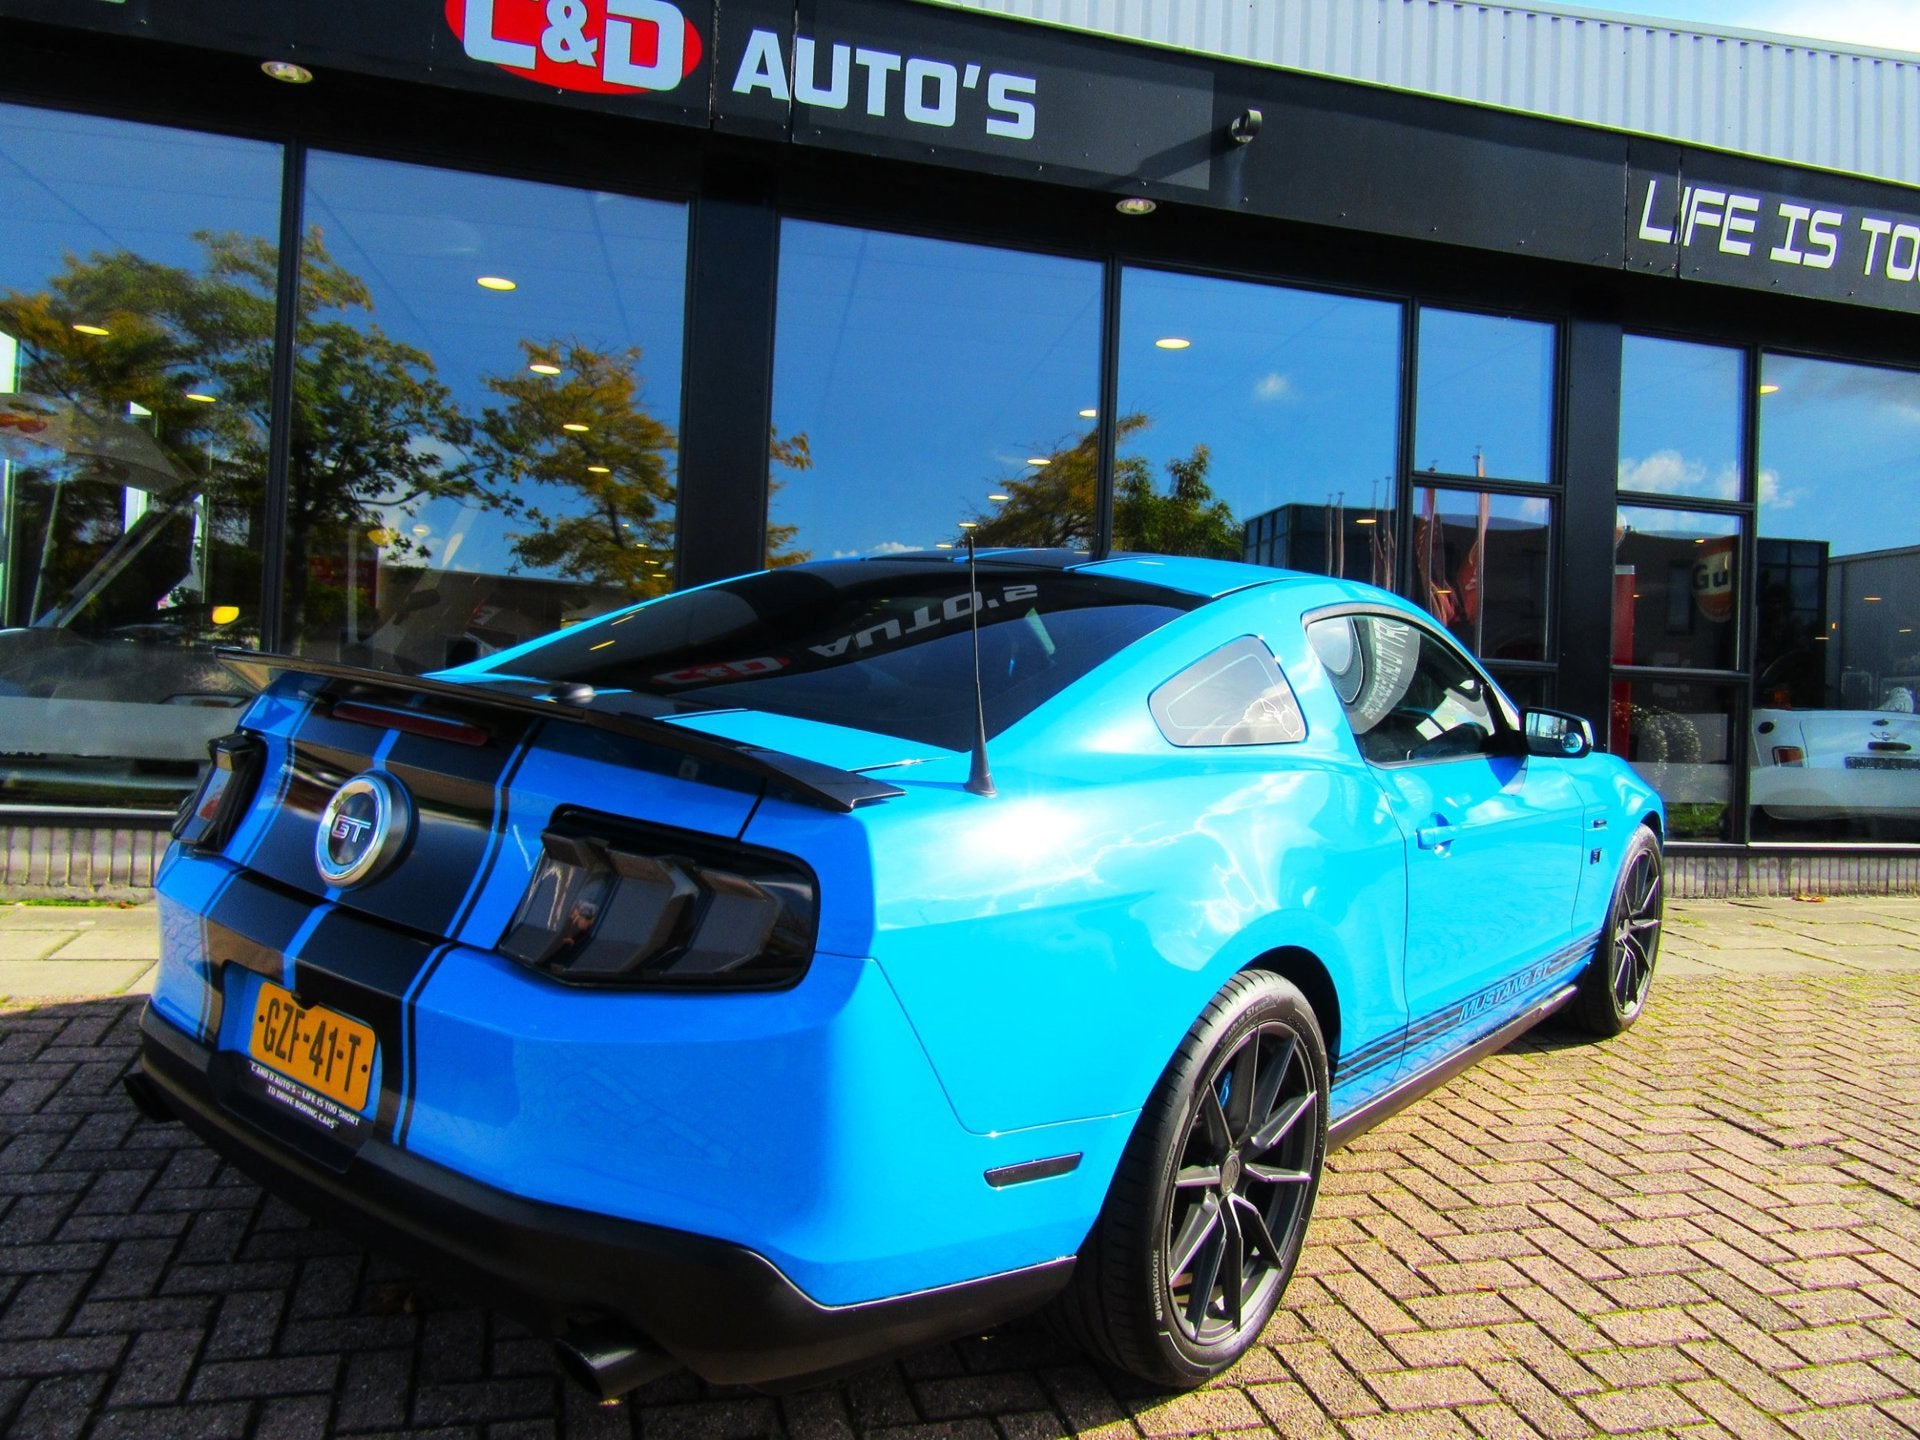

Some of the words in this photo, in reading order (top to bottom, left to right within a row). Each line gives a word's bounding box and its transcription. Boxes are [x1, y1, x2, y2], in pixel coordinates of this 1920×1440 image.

[463, 0, 686, 92] C&D
[732, 28, 1037, 141] AUTO'S
[1638, 180, 1760, 256] LIFE
[1769, 203, 1843, 269] IS
[1861, 217, 1920, 281] TO
[331, 814, 372, 843] GT
[1459, 970, 1532, 1021] MUSTANG
[1532, 960, 1552, 983] GT
[263, 997, 361, 1092] GZF-41-T
[267, 1085, 276, 1096] TO
[276, 1089, 294, 1106] DRIVE
[294, 1100, 318, 1119] BORING
[302, 1090, 316, 1104] LIFE
[316, 1096, 324, 1107] IS
[324, 1100, 337, 1115] TOO
[338, 1108, 360, 1126] SHORT
